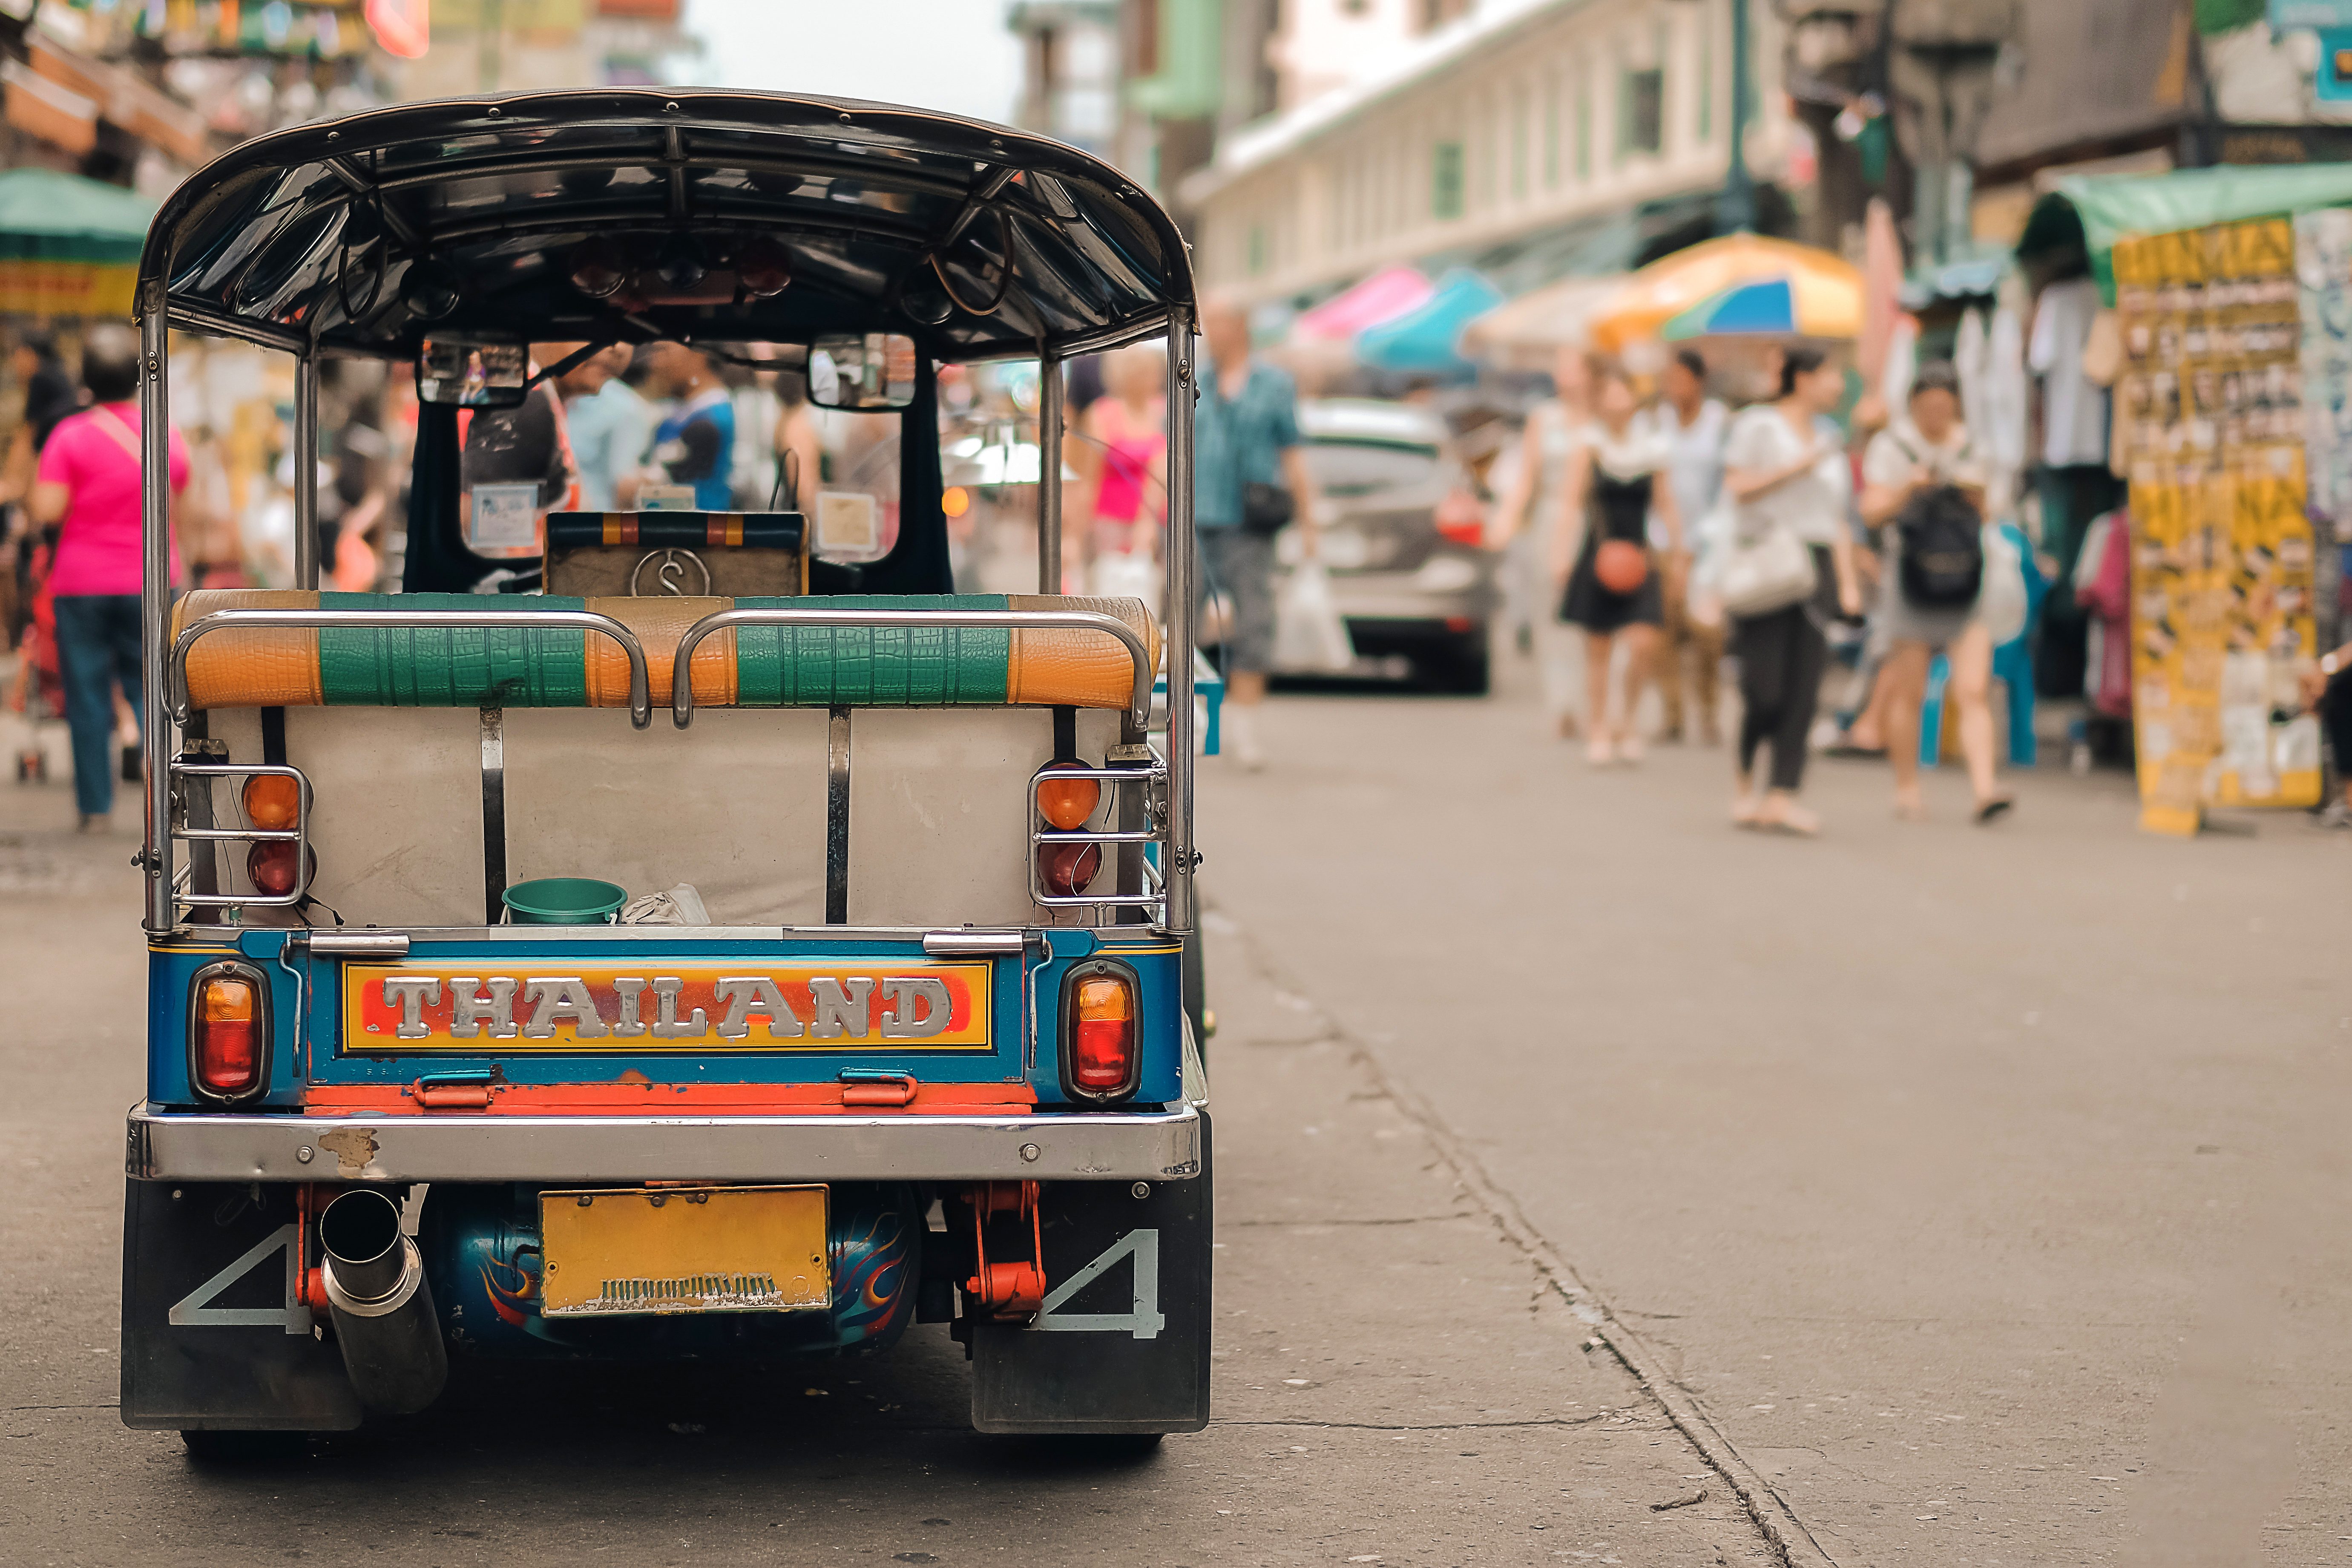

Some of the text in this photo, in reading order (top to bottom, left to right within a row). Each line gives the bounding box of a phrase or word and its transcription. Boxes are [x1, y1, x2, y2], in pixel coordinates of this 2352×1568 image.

[383, 976, 952, 1039] THAILAND
[169, 1223, 312, 1334] 4
[1022, 1229, 1165, 1339] 4
